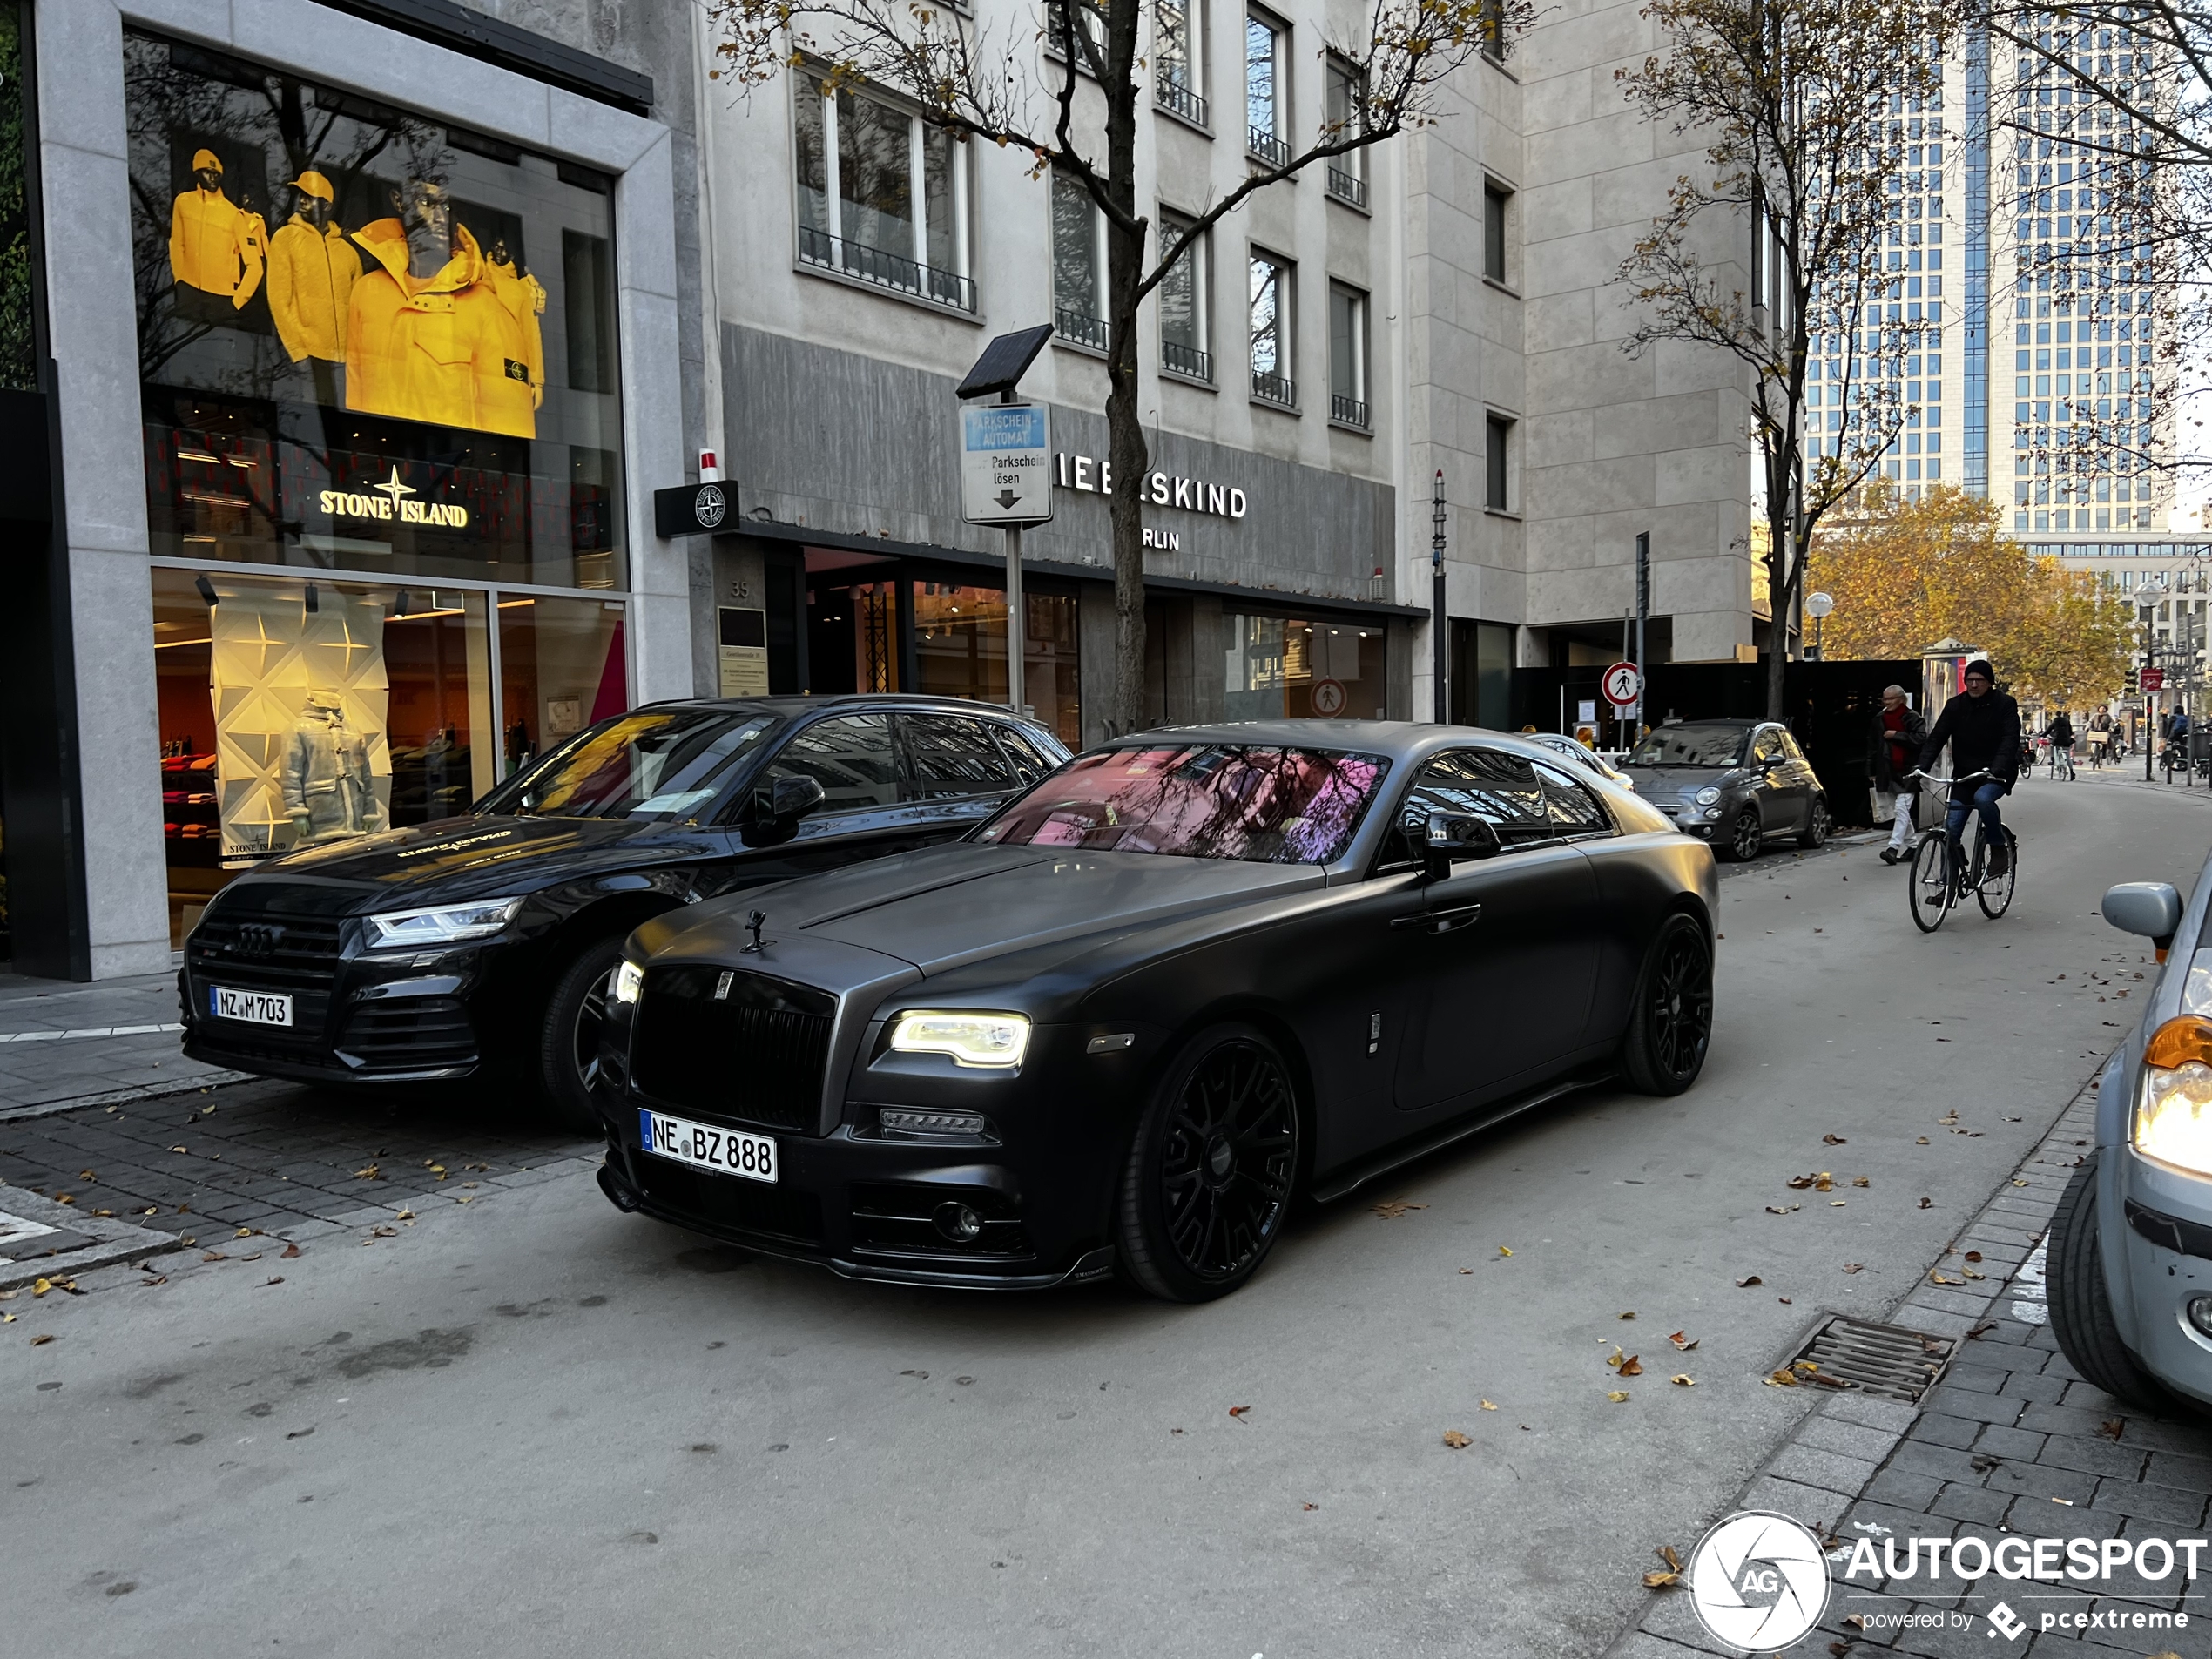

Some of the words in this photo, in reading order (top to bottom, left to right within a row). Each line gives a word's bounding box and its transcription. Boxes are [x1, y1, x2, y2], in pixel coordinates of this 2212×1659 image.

[983, 430, 1028, 447] AUTOMAT
[992, 454, 1045, 469] Parkschein
[994, 471, 1020, 484] lösen
[320, 490, 392, 520] STONE
[400, 499, 468, 528] ISLAND
[1143, 528, 1179, 550] RLIN
[732, 581, 749, 597] 35
[229, 844, 257, 853] STONE
[260, 842, 287, 851] ISLAND
